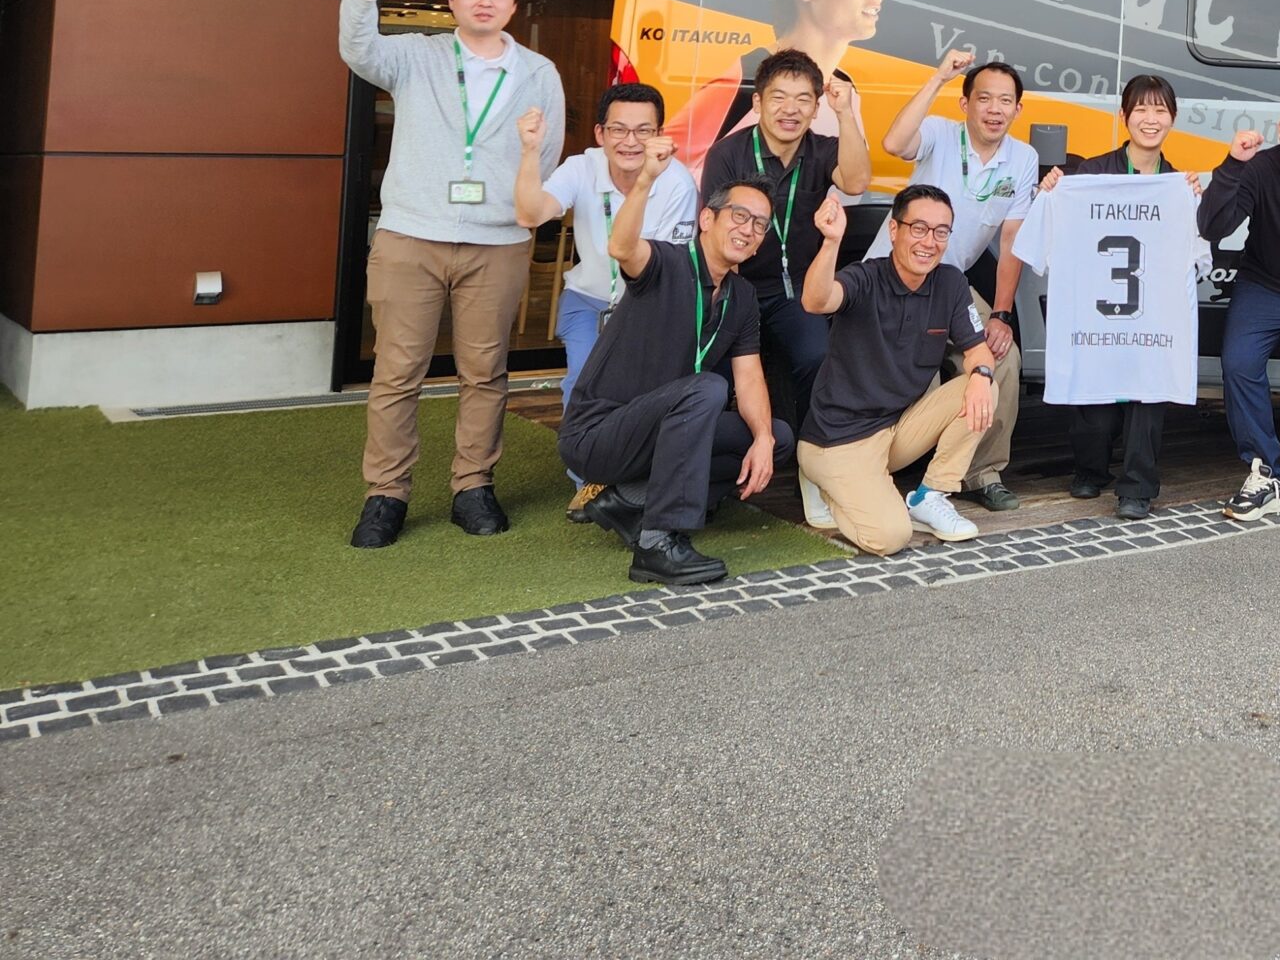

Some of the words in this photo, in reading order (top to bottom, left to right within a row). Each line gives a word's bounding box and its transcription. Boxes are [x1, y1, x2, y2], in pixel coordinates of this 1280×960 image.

[640, 27, 665, 41] KO
[671, 29, 752, 45] ITAKURA
[1091, 203, 1161, 221] ITAKURA
[1096, 235, 1145, 320] 3
